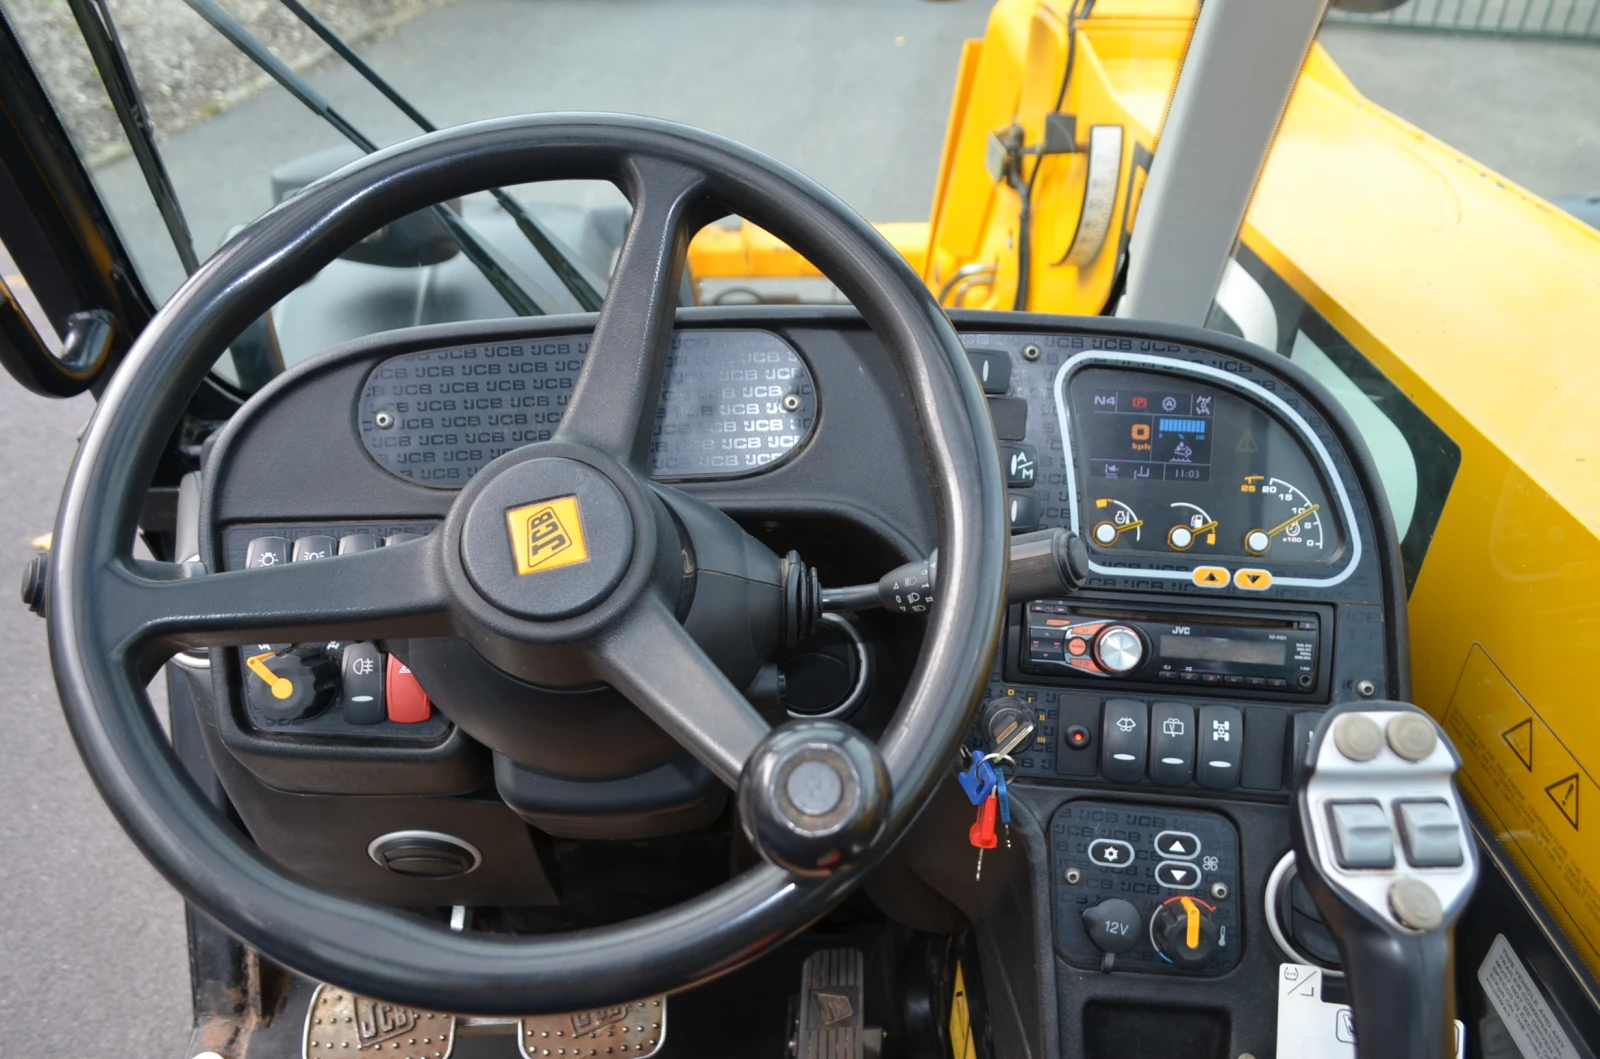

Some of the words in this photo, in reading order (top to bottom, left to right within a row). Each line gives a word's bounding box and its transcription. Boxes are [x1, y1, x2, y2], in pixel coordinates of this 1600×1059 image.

[485, 346, 524, 358] JCB
[531, 344, 570, 356] JCB
[1092, 338, 1132, 350] JCB
[415, 366, 454, 378] JCB
[462, 364, 501, 376] JCB
[508, 362, 548, 374] JCB
[555, 360, 584, 372] JC
[393, 384, 432, 396] JCB
[440, 382, 479, 394] JCB
[486, 380, 526, 392] JCB
[533, 378, 572, 390] JCB
[742, 386, 782, 398] JCB
[417, 400, 456, 412] JCB
[464, 398, 503, 410] JCB
[510, 396, 550, 408] JCB
[1094, 396, 1116, 406] N4
[720, 404, 760, 415] JCB
[442, 416, 481, 428] JCB
[488, 414, 528, 426] JCB
[535, 412, 564, 424] JC
[744, 420, 784, 432] JCB
[419, 434, 458, 446] JCB
[466, 432, 505, 444] JCB
[512, 430, 551, 442] JCB
[722, 437, 762, 449] JCB
[1132, 443, 1151, 451] kph
[397, 452, 436, 464] JCB
[444, 450, 482, 462] JCB
[421, 468, 460, 480] JCB
[1176, 469, 1200, 479] 11:03
[1240, 484, 1256, 493] 25
[1262, 486, 1277, 494] 20
[531, 511, 566, 557] JCB
[1172, 626, 1190, 635] JVC
[1126, 814, 1166, 828] JCB
[1120, 882, 1160, 895] JCB
[1105, 920, 1129, 936] 12V
[1484, 976, 1511, 1017] HIGHWAY
[1501, 948, 1515, 968] THIS
[1514, 968, 1539, 1006] VEHICLE
[1538, 1008, 1552, 1027] AND
[1551, 1029, 1565, 1048] ANY
[1491, 965, 1514, 1000] SPEEDS
[1512, 1000, 1520, 1011] IN
[1519, 1011, 1543, 1048] EXCESS
[1494, 960, 1510, 982] MUST
[1509, 984, 1522, 1003] NOT
[1522, 1004, 1530, 1016] BE
[1530, 1019, 1553, 1054] DRIVEN
[1497, 954, 1522, 990] TRAILER
[1521, 991, 1562, 1055] COMBINATION
[1504, 998, 1514, 1012] ON
[1513, 1012, 1526, 1031] THE
